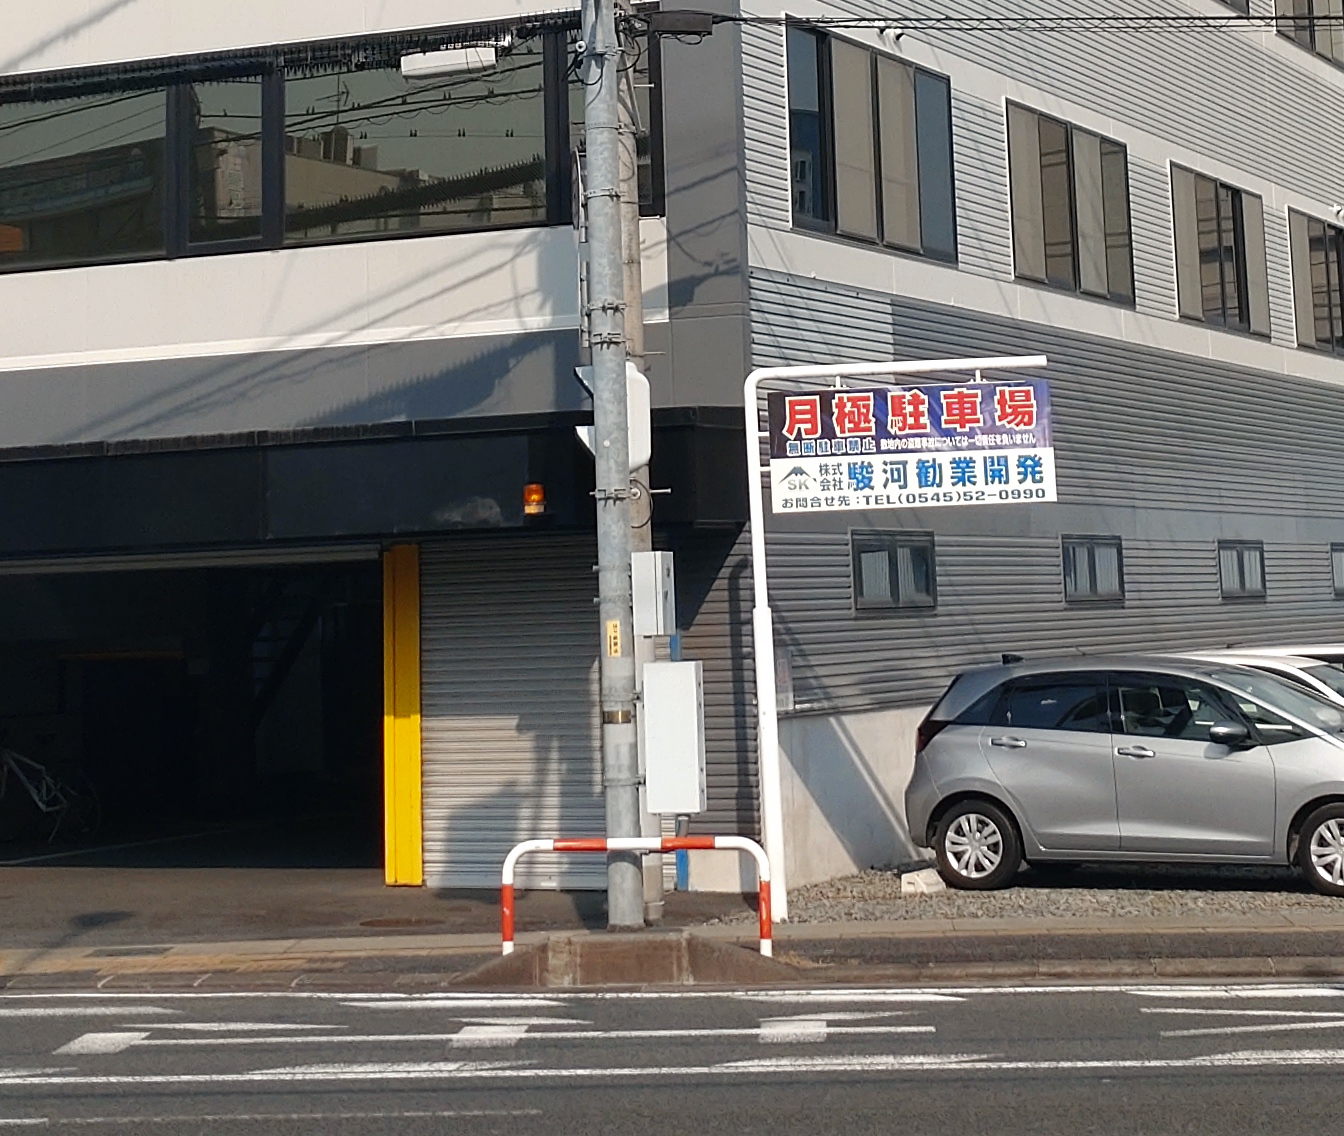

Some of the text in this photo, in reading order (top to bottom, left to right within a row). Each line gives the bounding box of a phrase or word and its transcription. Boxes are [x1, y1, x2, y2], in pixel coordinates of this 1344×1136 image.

[783, 386, 1037, 438] 月極駐車場
[819, 463, 843, 477] 株式
[847, 453, 1044, 492] 駿河勧業開発
[788, 479, 810, 491] SK
[819, 477, 844, 492] 会社
